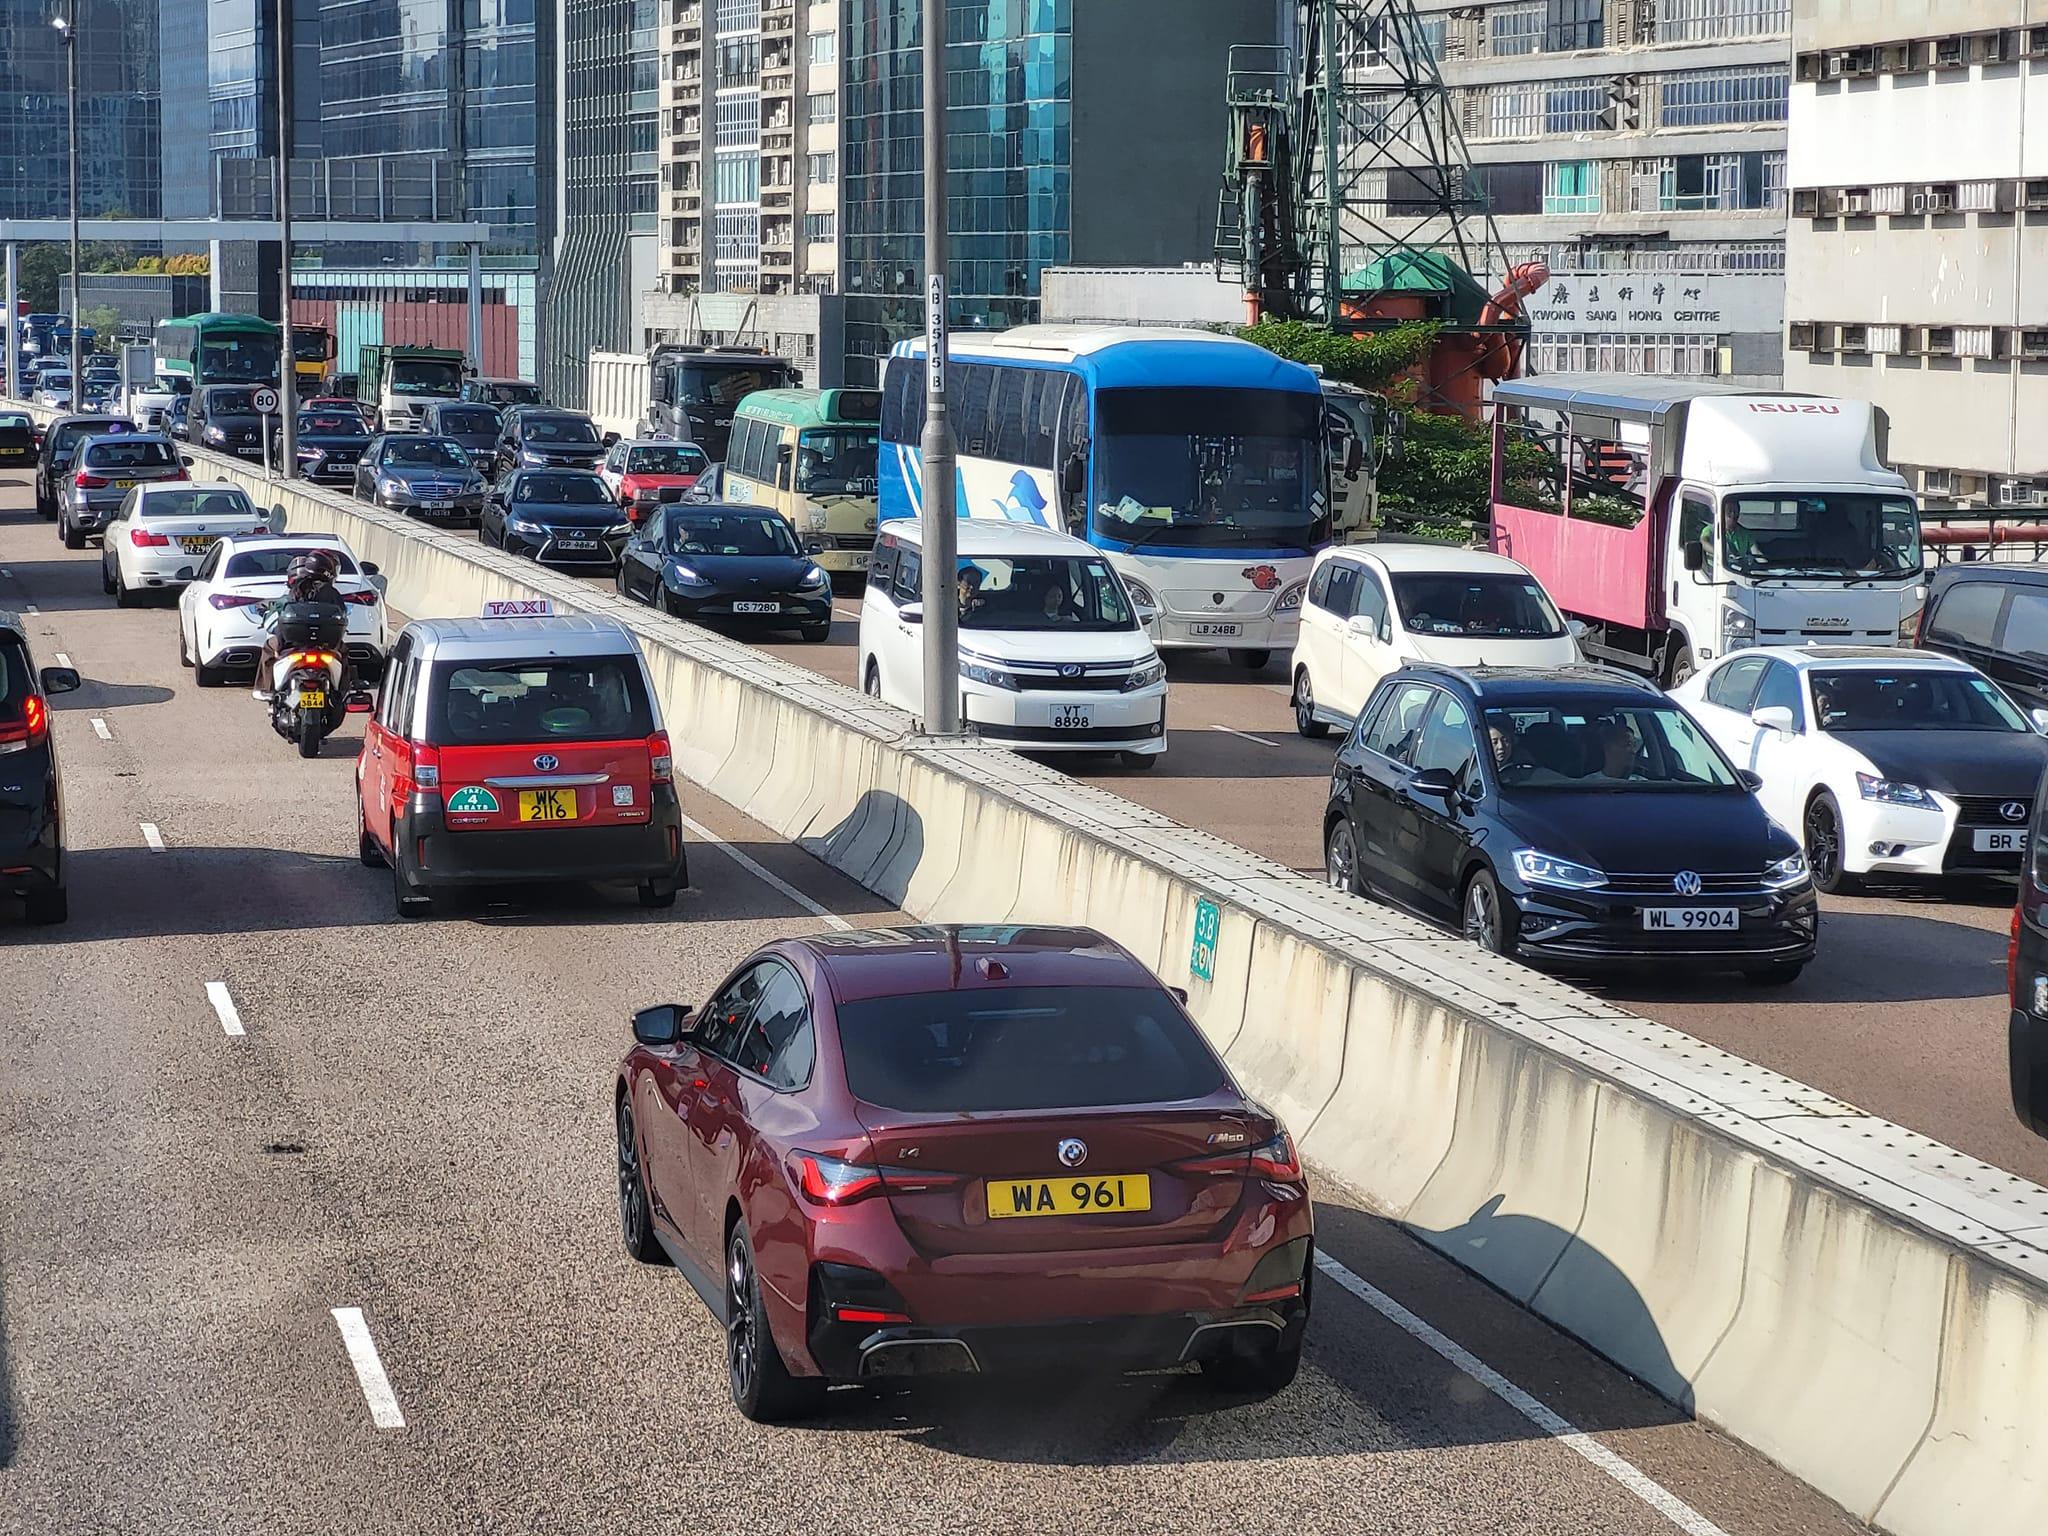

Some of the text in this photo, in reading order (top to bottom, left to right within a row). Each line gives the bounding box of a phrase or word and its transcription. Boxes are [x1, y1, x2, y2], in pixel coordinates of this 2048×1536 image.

[1532, 310, 1721, 322] KWONG SANG HONG CENTRE
[256, 395, 274, 406] 80
[1748, 403, 1839, 414] ISUZU
[488, 601, 547, 614] TAXI
[737, 603, 776, 612] GS 7280
[1197, 626, 1209, 634] LB
[1064, 705, 1081, 716] VT
[1055, 716, 1089, 728] 8898
[468, 794, 478, 804] 4
[536, 791, 559, 805] WK
[531, 804, 567, 820] 2116
[1990, 834, 2012, 848] BR
[1650, 910, 1734, 927] WL 9904
[1012, 1180, 1125, 1212] WA 961
